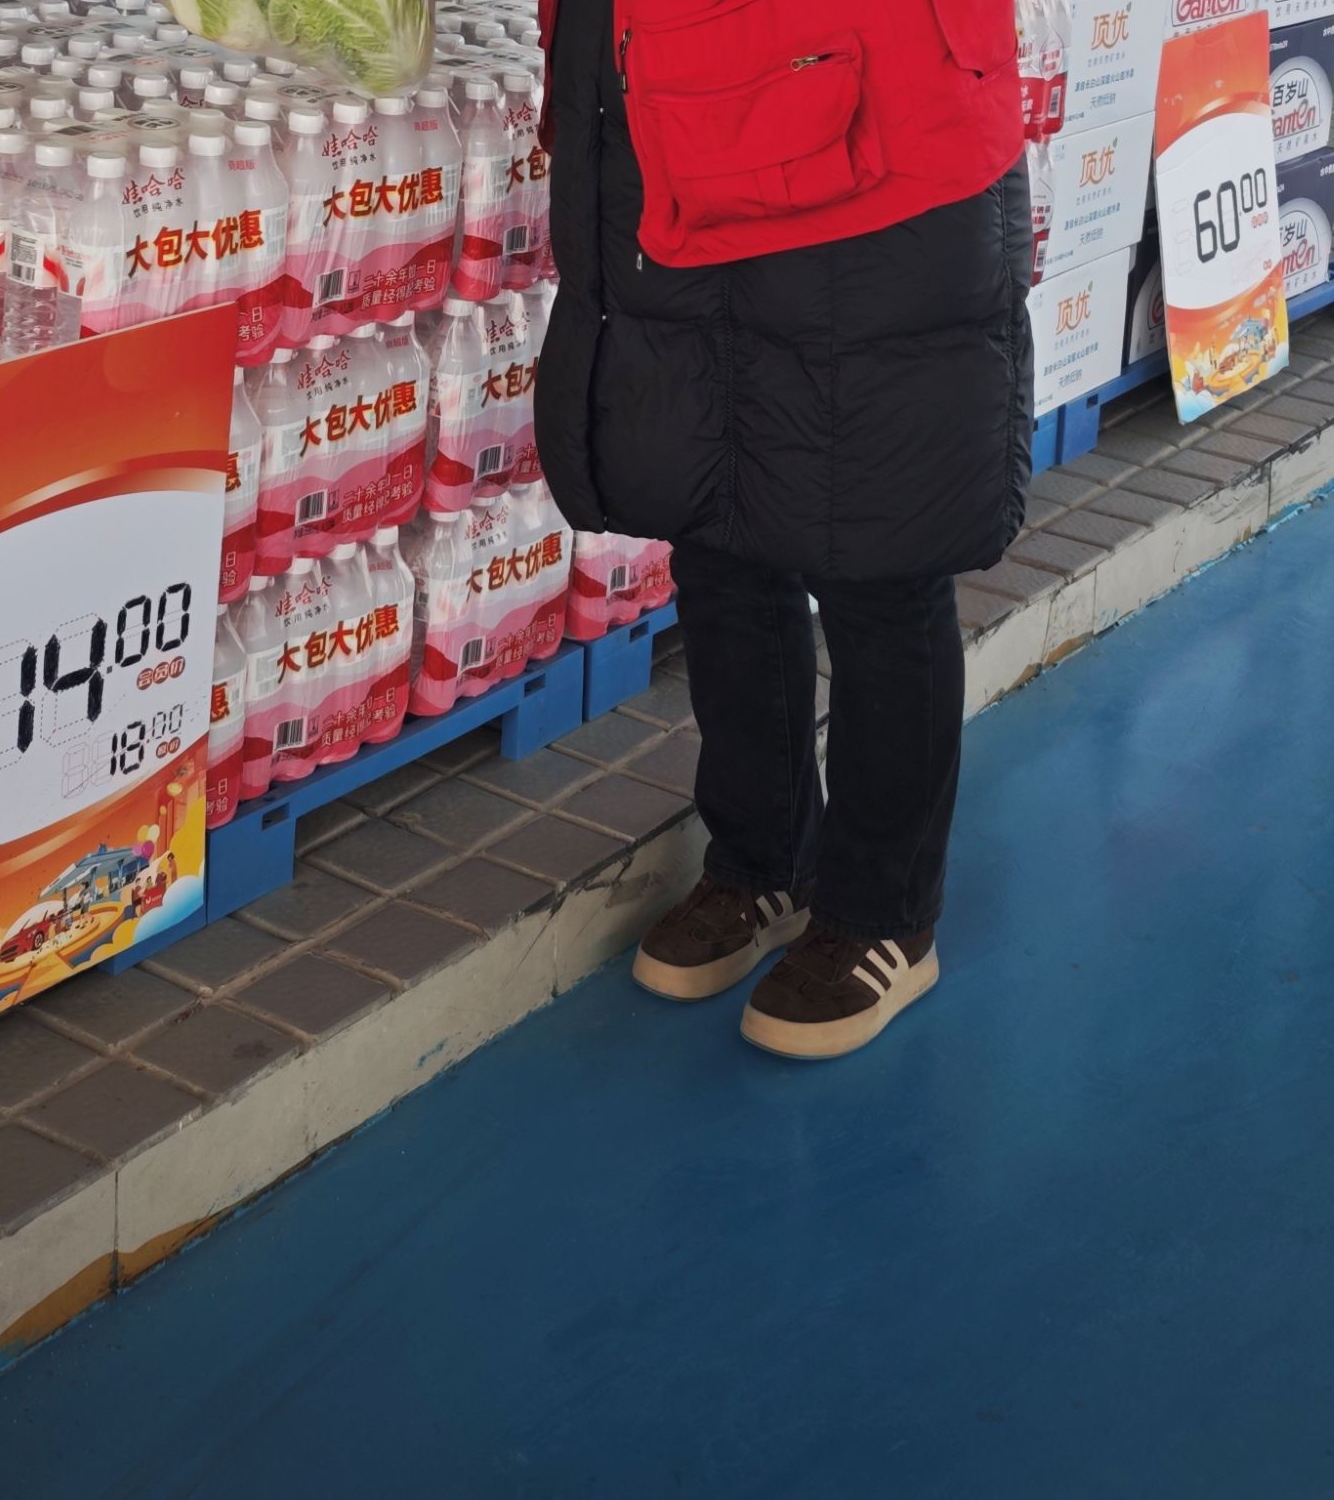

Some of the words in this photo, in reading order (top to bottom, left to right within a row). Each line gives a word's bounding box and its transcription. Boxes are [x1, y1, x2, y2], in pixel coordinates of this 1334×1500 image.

[1091, 4, 1131, 51] 顶优
[1272, 78, 1308, 107] 百岁山
[322, 125, 379, 158] 娃哈哈
[1271, 99, 1316, 140] anten
[122, 167, 186, 206] 娃哈哈
[1079, 140, 1116, 188] 顶优
[323, 167, 444, 227] 大包大优惠
[1194, 168, 1267, 263] 60.00
[126, 209, 265, 278] 大包大优惠
[238, 323, 265, 342] 考验
[483, 311, 530, 344] 娃哈哈
[1056, 283, 1092, 335] 顶优
[297, 350, 351, 390] 娃哈哈
[299, 380, 417, 457] 大包大优惠
[466, 530, 562, 603] 大包大优惠
[275, 575, 333, 617] 娃哈哈
[277, 604, 400, 684] 大包大优惠
[17, 582, 192, 754] 14.00
[137, 656, 186, 691] 会员价
[110, 703, 184, 775] 18.00
